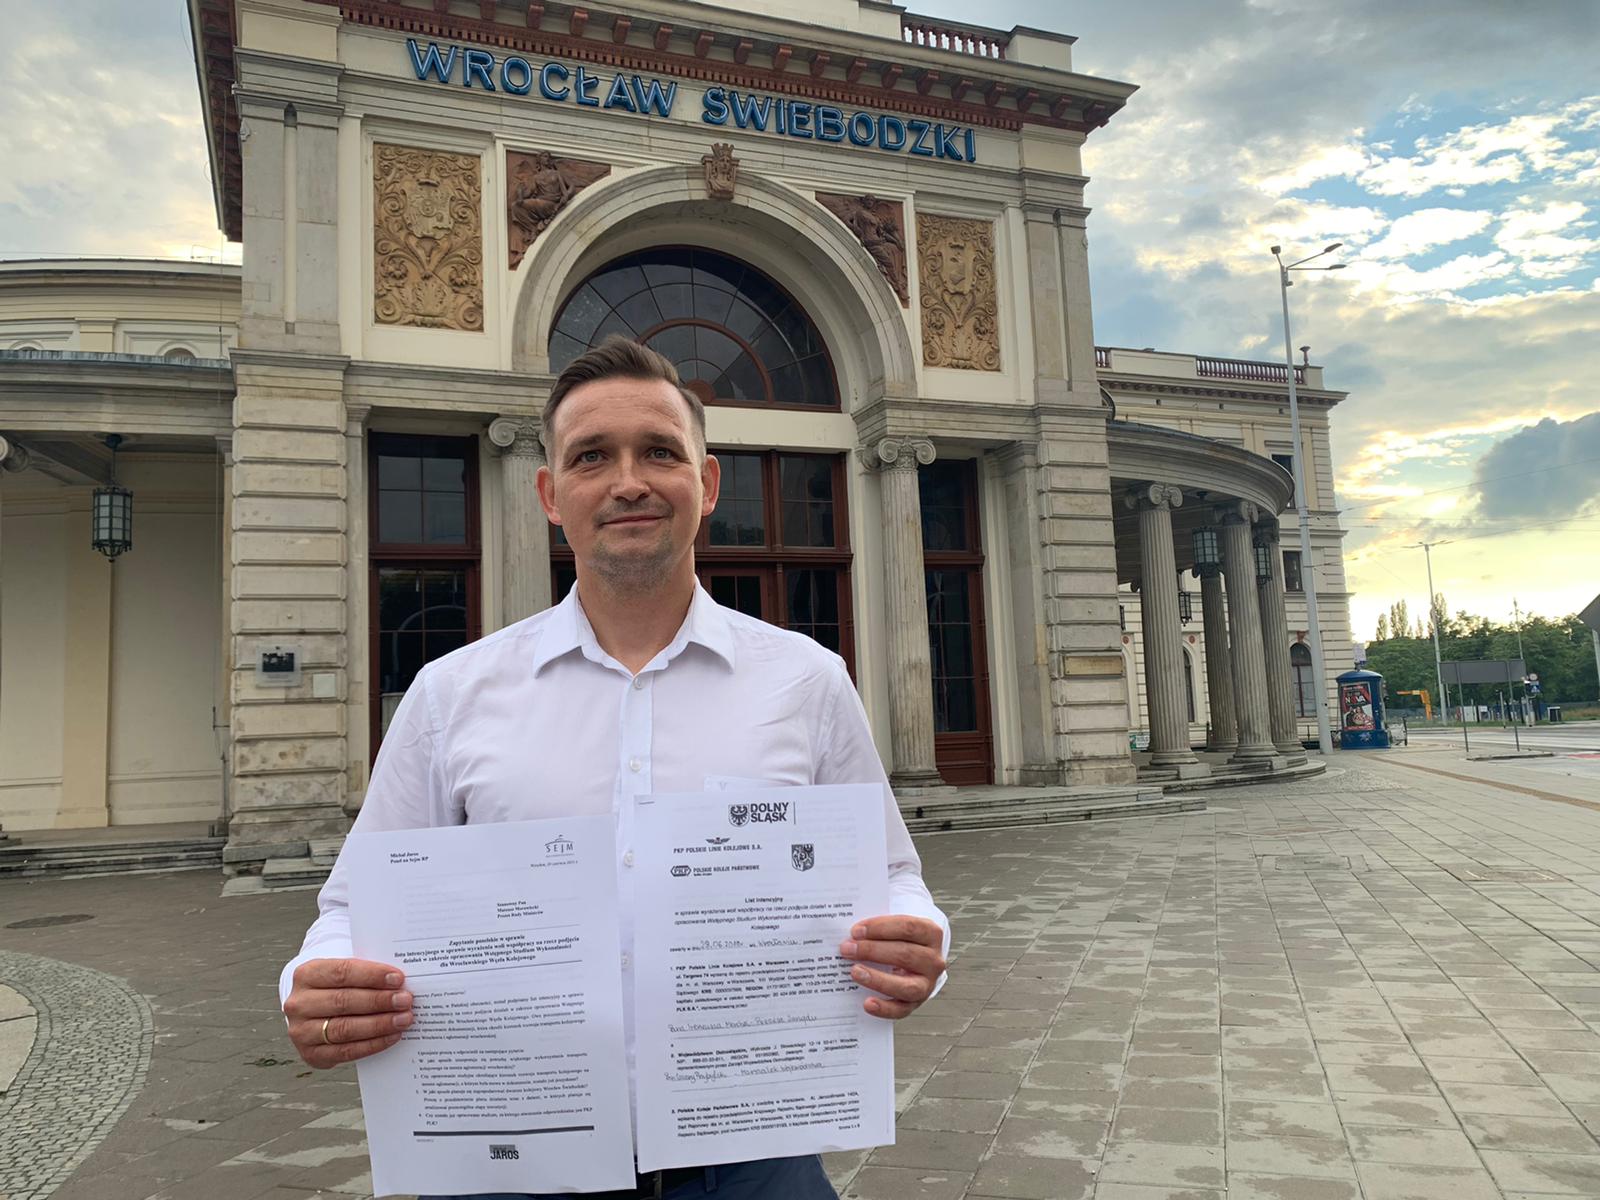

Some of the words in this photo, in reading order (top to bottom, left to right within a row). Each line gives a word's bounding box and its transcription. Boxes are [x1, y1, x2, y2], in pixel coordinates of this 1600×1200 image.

[406, 38, 678, 118] WROCŁAW
[750, 802, 789, 813] DOLNY
[546, 843, 574, 854] SEJM
[490, 1150, 520, 1160] JAROS
